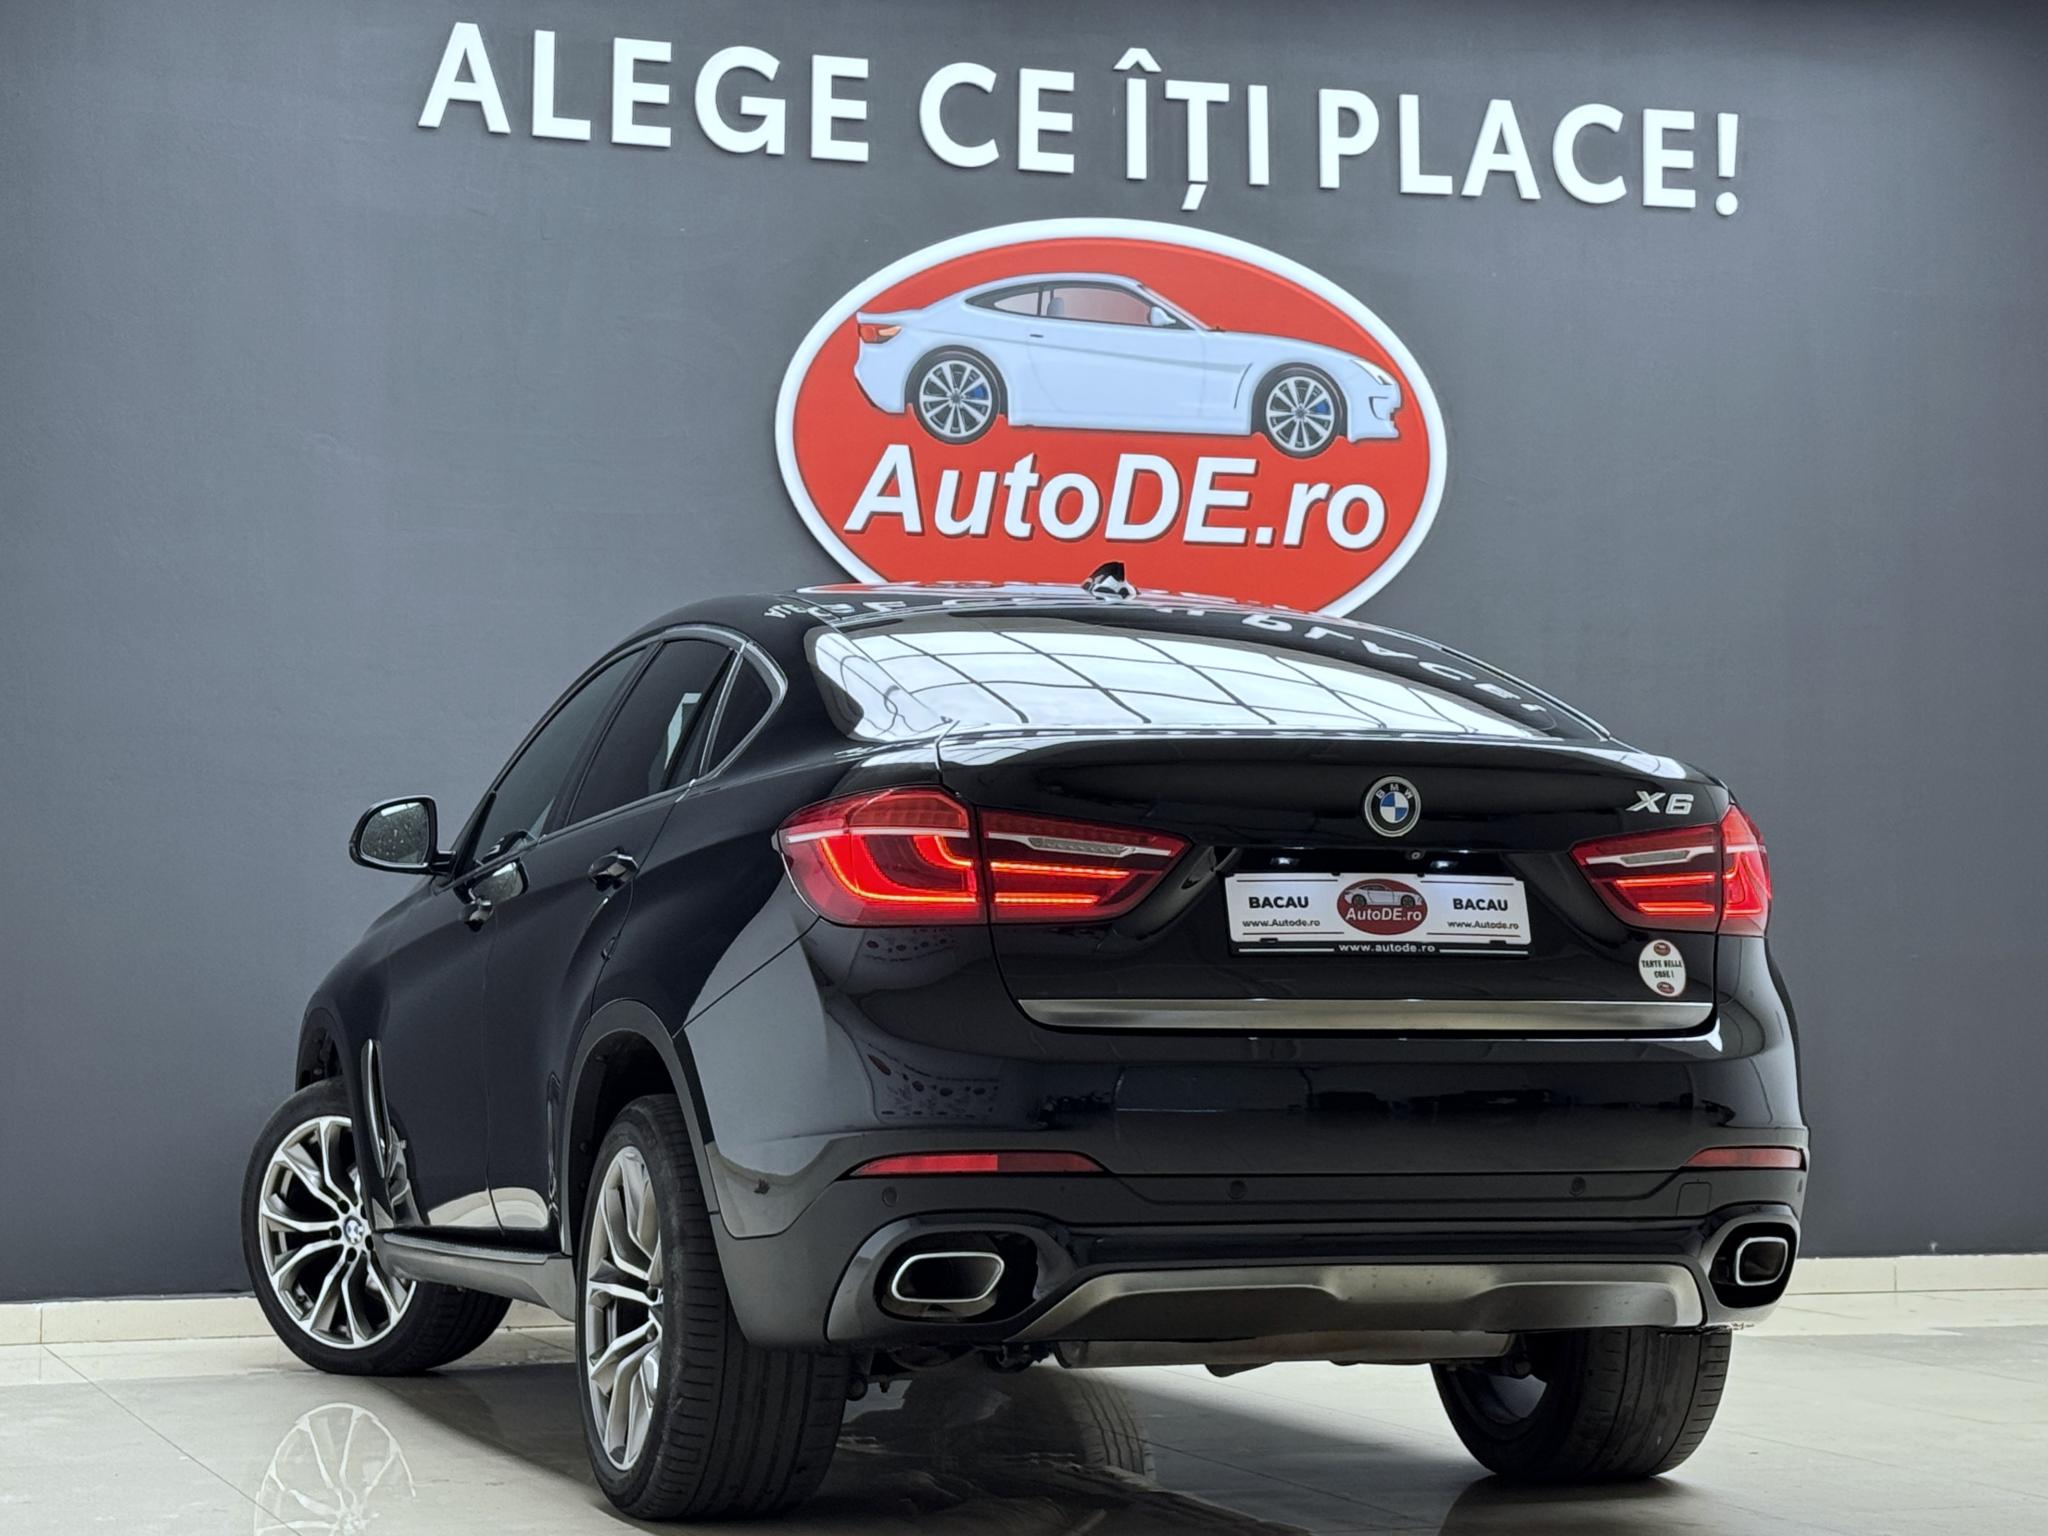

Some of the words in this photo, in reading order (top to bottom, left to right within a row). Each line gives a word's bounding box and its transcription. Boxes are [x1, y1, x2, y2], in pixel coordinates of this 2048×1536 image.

[418, 21, 870, 162] ALEGE
[918, 62, 1075, 174] CE
[1318, 88, 1740, 217] PLACE!
[843, 443, 1388, 550] AutoDE.ro
[1375, 783, 1413, 800] BMW
[1625, 790, 1694, 815] X6
[1248, 896, 1309, 909] BACAU
[1452, 898, 1509, 912] BACAU
[1345, 907, 1422, 921] AutoDE.ro
[1242, 918, 1321, 928] www.Autode.ro
[1447, 920, 1519, 930] www.Autode.ro
[1338, 943, 1436, 953] www.autode.ro
